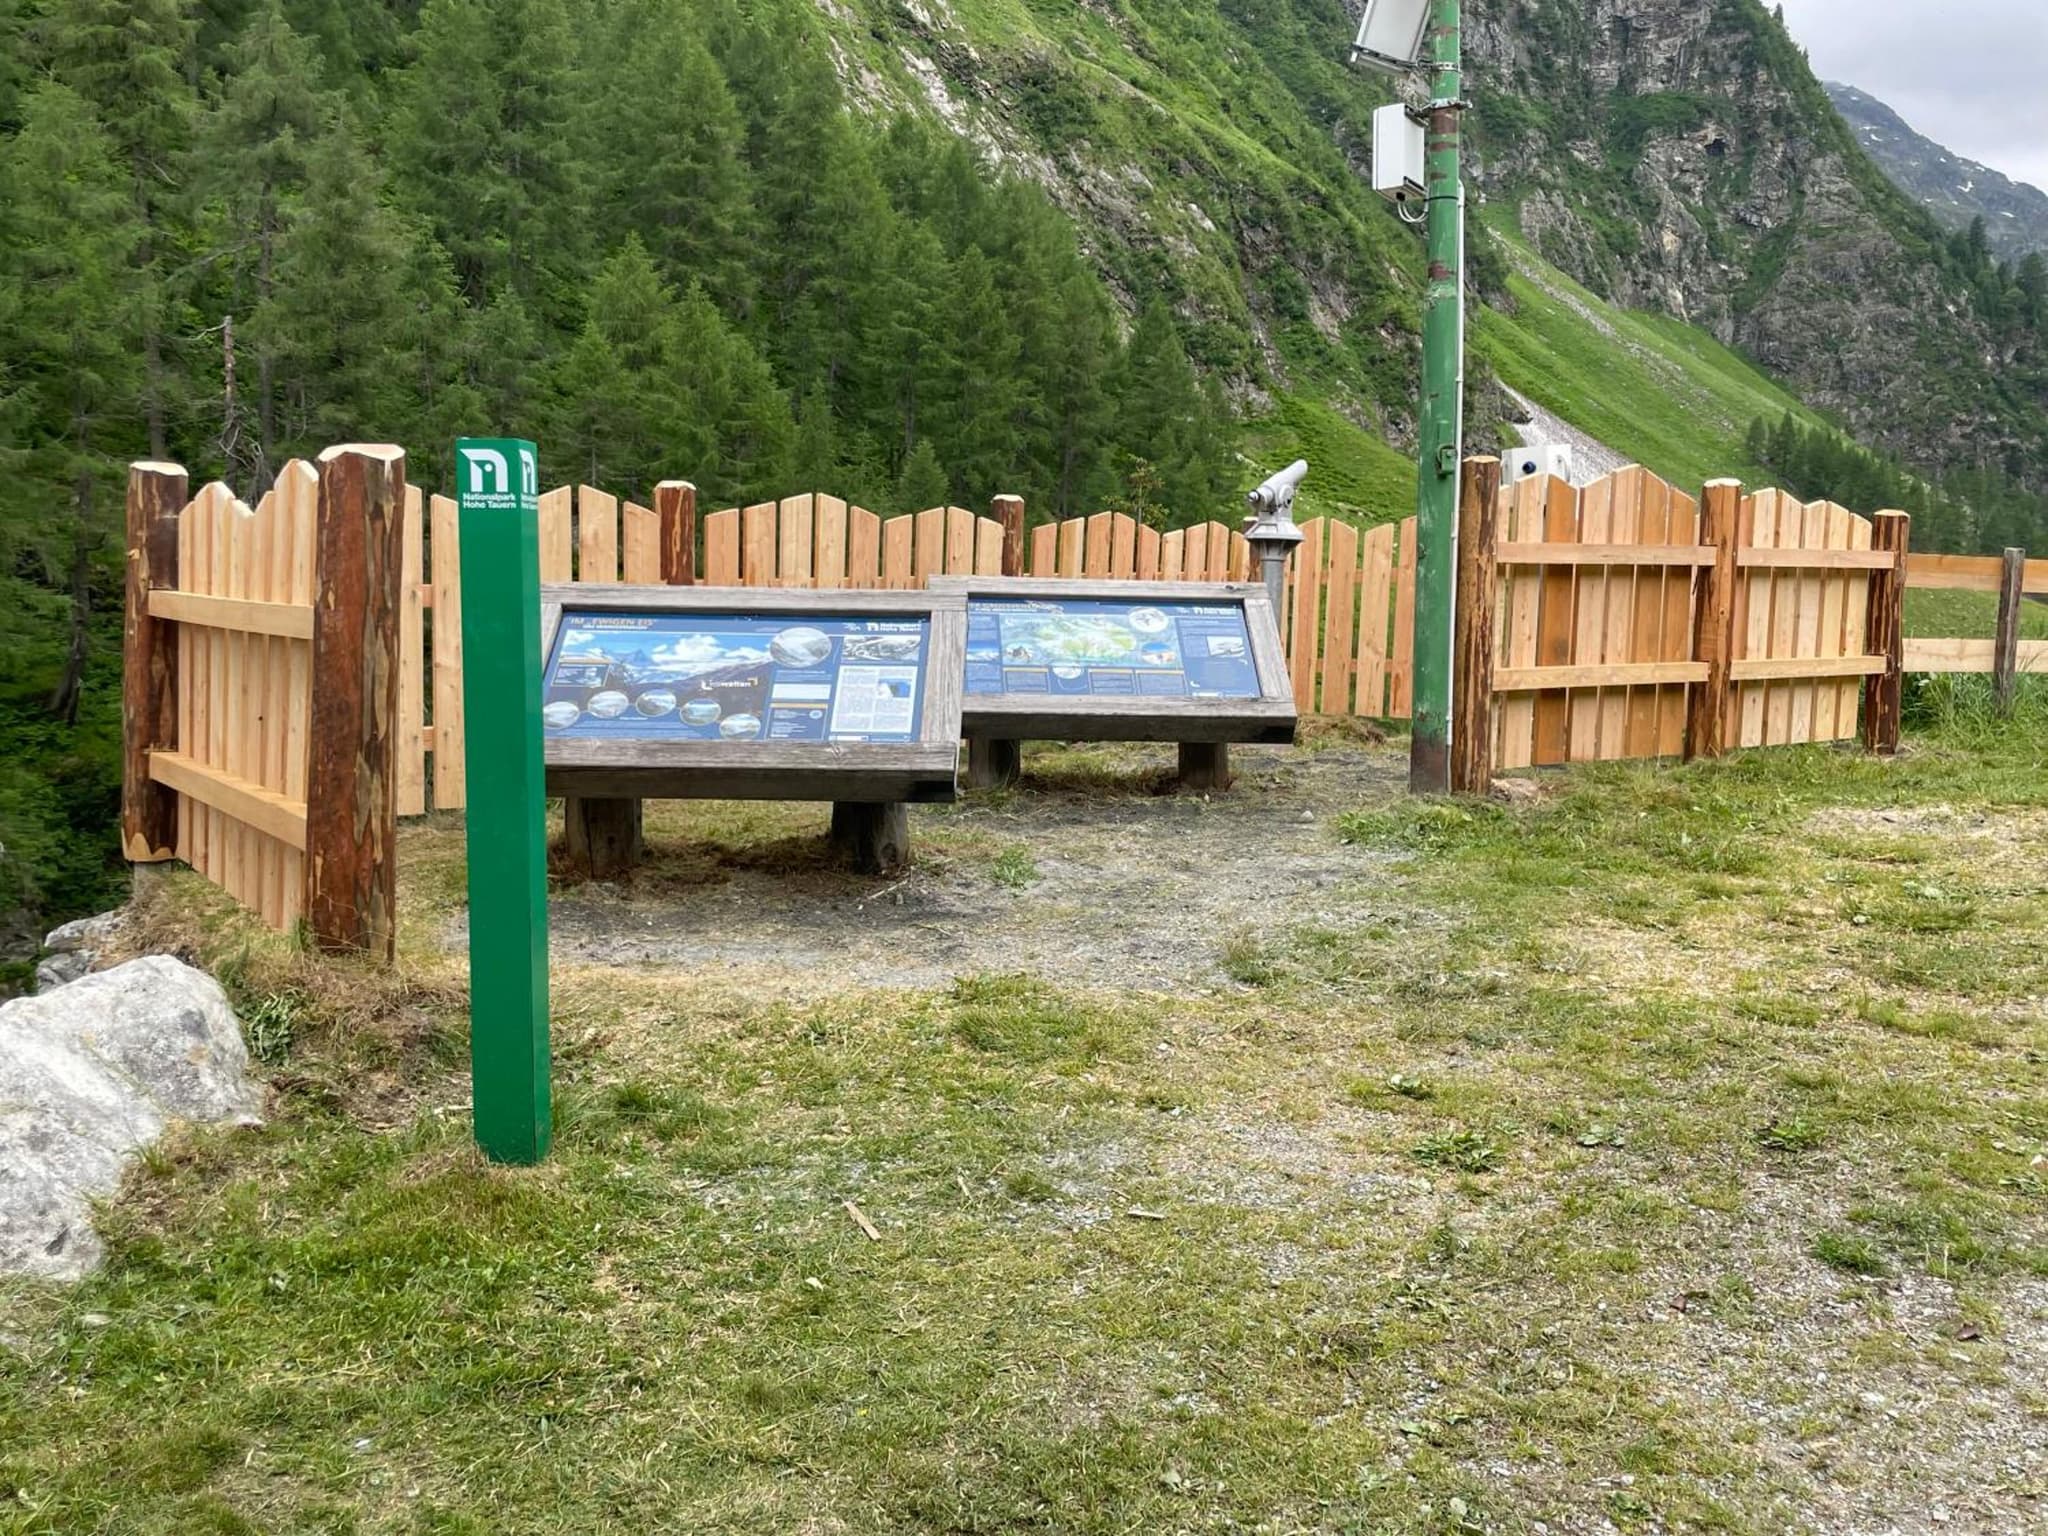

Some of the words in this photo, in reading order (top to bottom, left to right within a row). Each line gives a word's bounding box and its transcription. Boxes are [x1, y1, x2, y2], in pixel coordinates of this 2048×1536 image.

[463, 493, 516, 501] Nationalpark
[463, 501, 487, 509] Hohe
[487, 501, 517, 509] Tauern
